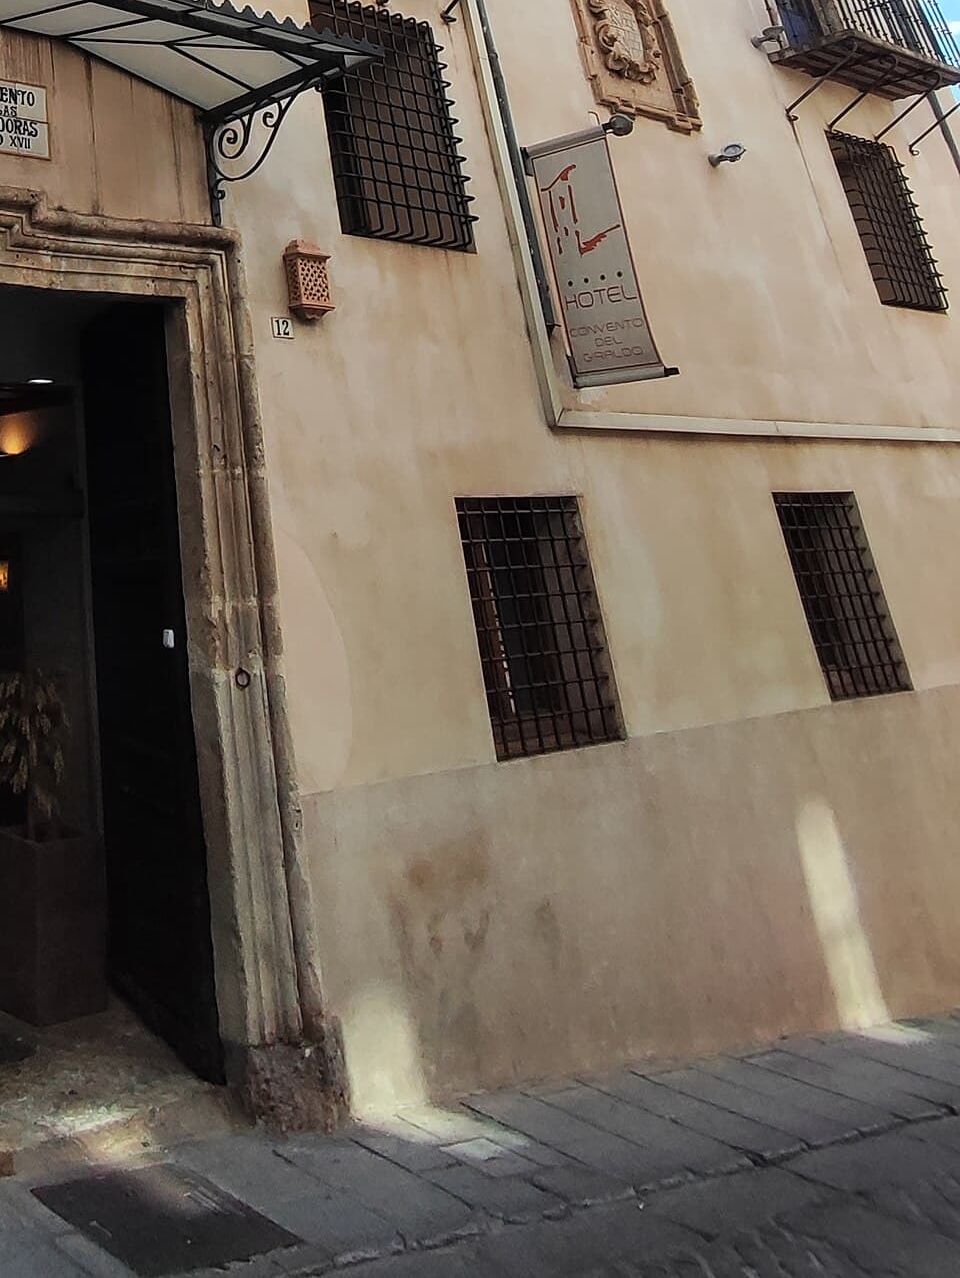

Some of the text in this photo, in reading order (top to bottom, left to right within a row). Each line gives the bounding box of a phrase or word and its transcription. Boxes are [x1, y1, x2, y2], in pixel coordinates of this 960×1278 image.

[9, 135, 31, 150] XVII
[564, 284, 638, 311] HOTEL
[274, 319, 290, 336] 12
[569, 317, 644, 338] CONVENTO
[594, 336, 623, 348] DEL
